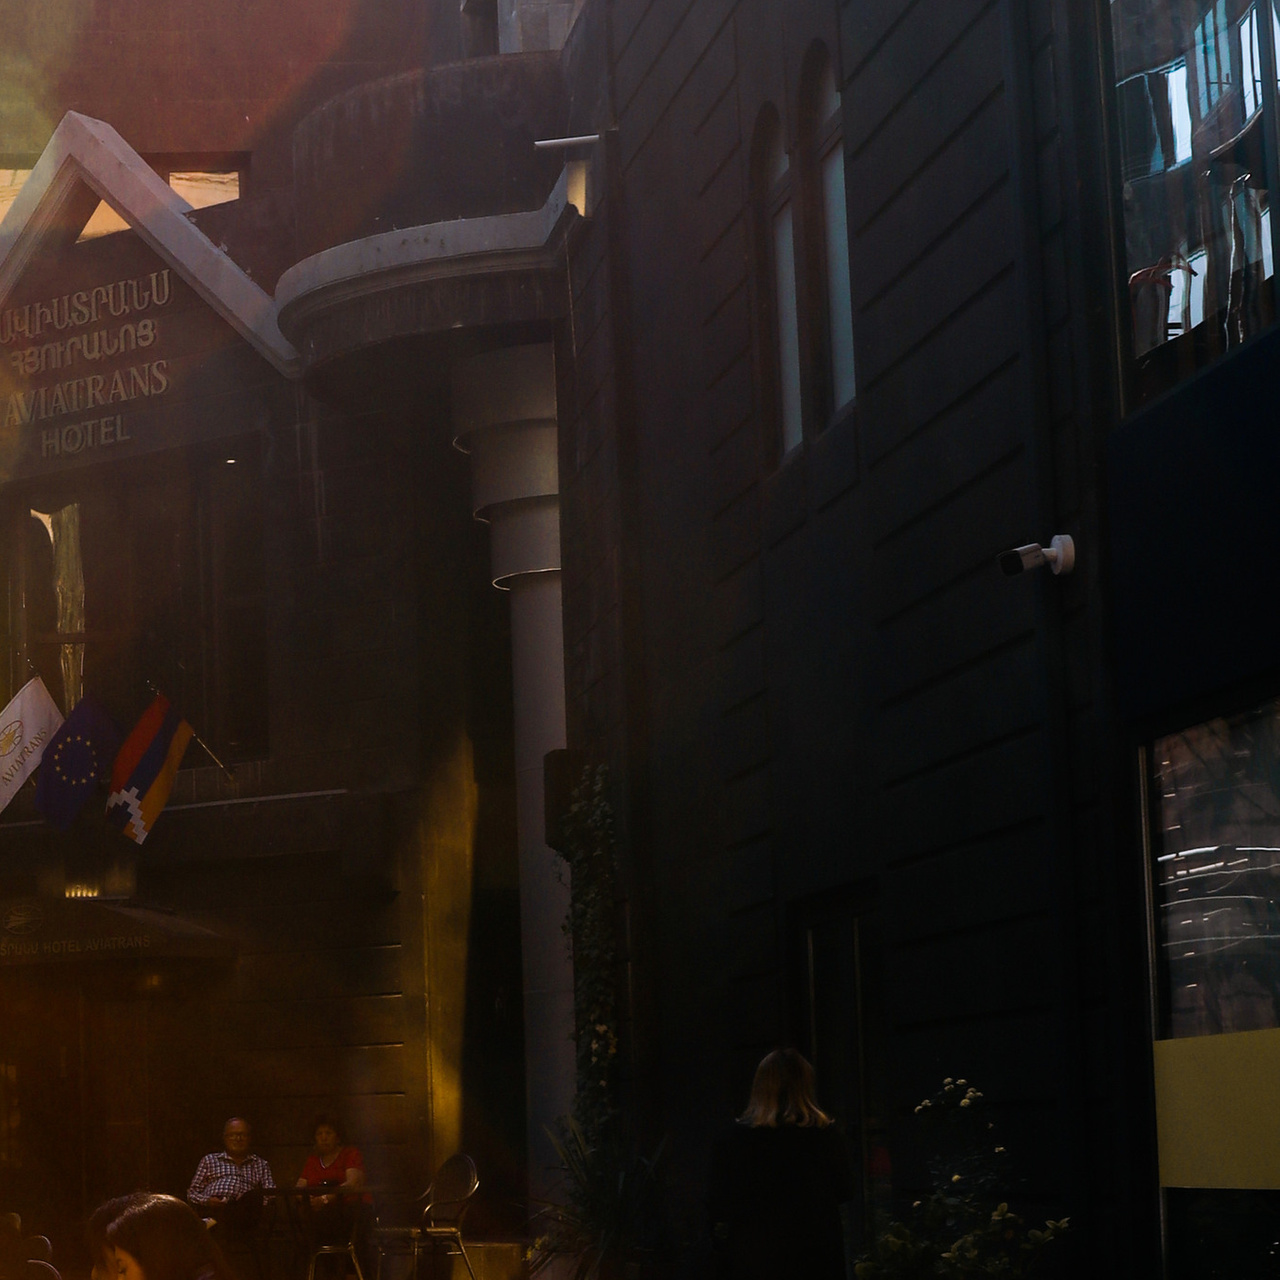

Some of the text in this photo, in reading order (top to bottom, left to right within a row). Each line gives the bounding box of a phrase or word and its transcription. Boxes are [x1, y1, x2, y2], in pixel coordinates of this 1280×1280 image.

[5, 360, 169, 428] AVIATRANS
[41, 415, 131, 458] HOTEL
[2, 730, 46, 786] AVIATRANS
[44, 940, 82, 954] HOTEL
[85, 935, 151, 951] AVIATRANS
